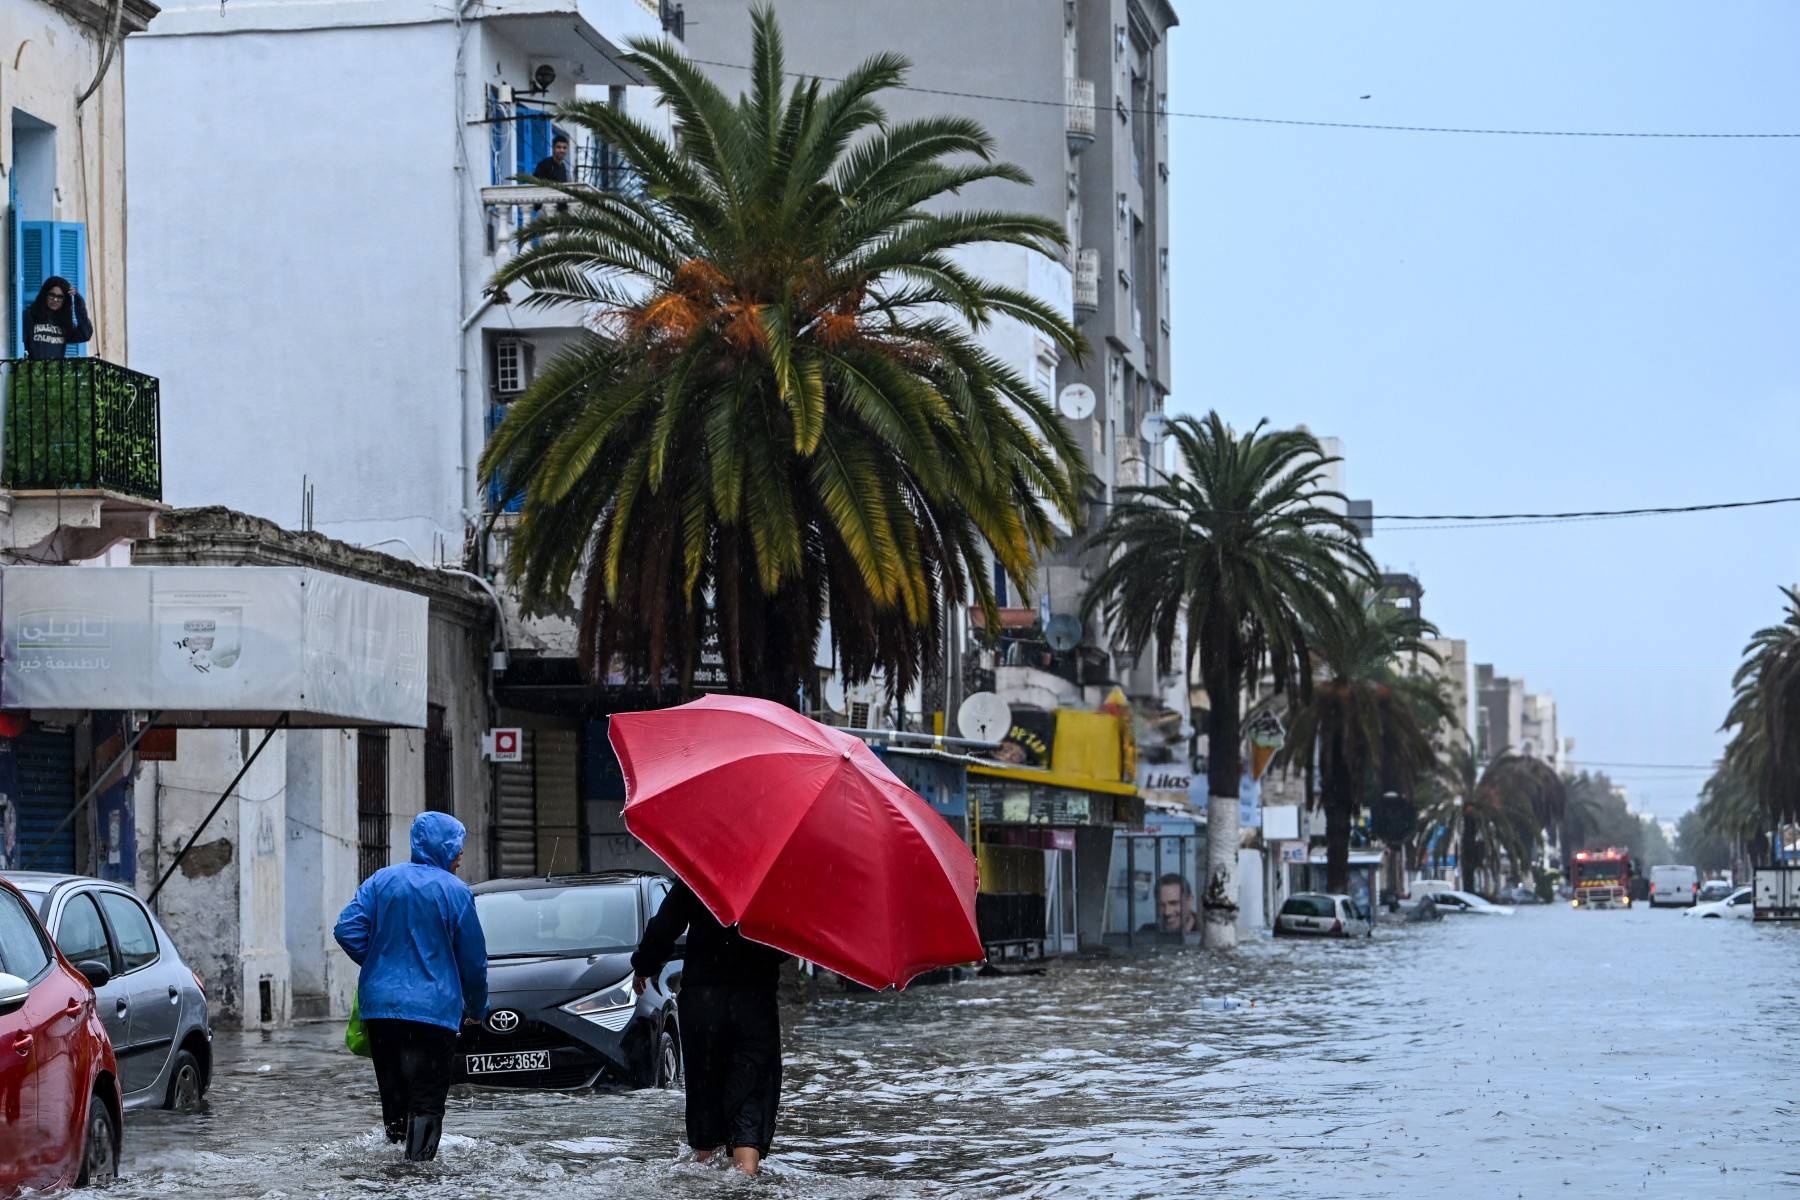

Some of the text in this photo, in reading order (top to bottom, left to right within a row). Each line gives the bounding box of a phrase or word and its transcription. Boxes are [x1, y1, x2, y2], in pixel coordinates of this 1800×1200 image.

[18, 655, 42, 673] خير
[1145, 772, 1191, 789] Lilas
[472, 1056, 495, 1072] 214
[515, 1053, 545, 1069] 3652
